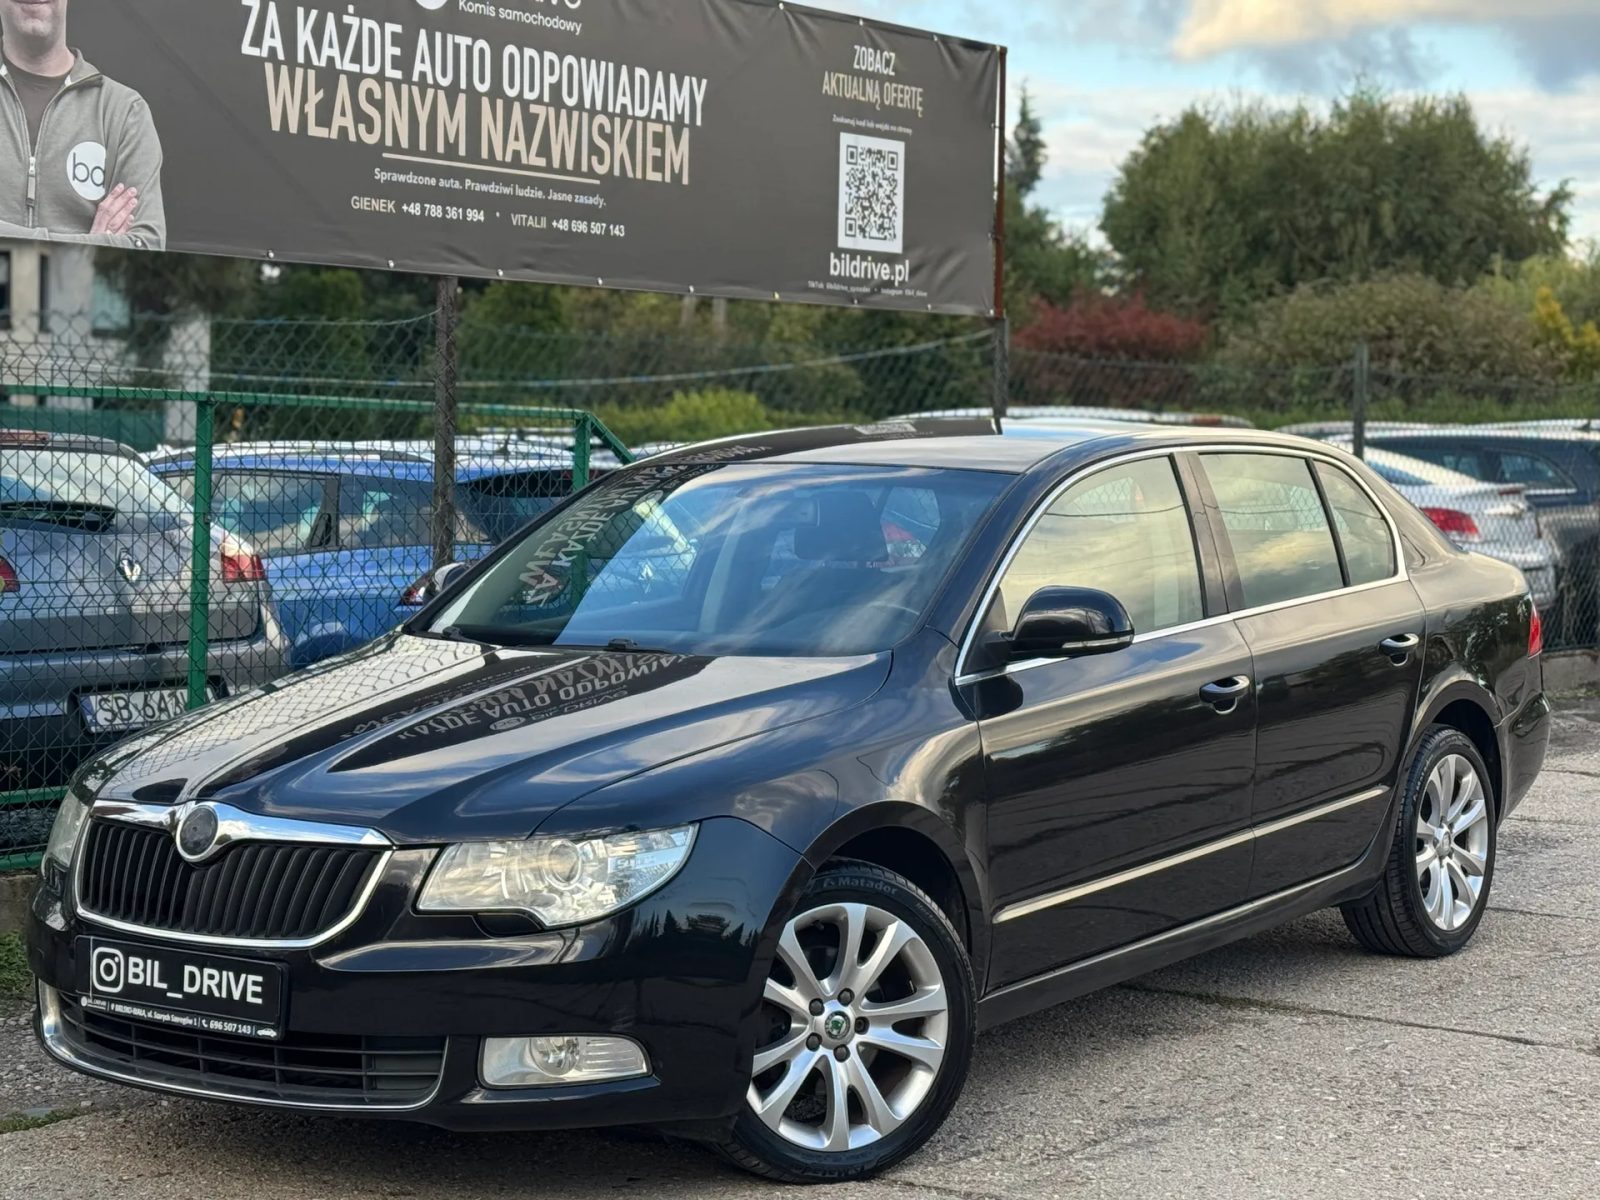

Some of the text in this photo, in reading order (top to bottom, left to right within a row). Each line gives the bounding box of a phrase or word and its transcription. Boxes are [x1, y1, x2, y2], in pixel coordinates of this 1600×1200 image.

[458, 0, 582, 35] Komis samochodowy
[240, 0, 707, 127] ZA KAŻDE AUTO ODPOWIADAMY
[853, 45, 896, 77] ZOBACZ
[822, 71, 924, 117] AKTUALNĄ OFERTĘ
[264, 62, 690, 186] WŁASNYM NAZWISKIEM
[374, 168, 607, 209] Sprawdzone auta. Prawdziwi ludzie. Jasne zasady.
[351, 196, 485, 223] GIENEK +48 788 361 994
[511, 213, 626, 238] VITALII +48 696 507 143
[829, 253, 910, 287] bildrive.pl
[98, 696, 133, 723] SB
[838, 876, 899, 895] Matador
[128, 956, 264, 1005] BIL_DRIVE
[209, 1019, 251, 1034] 696 507 143
